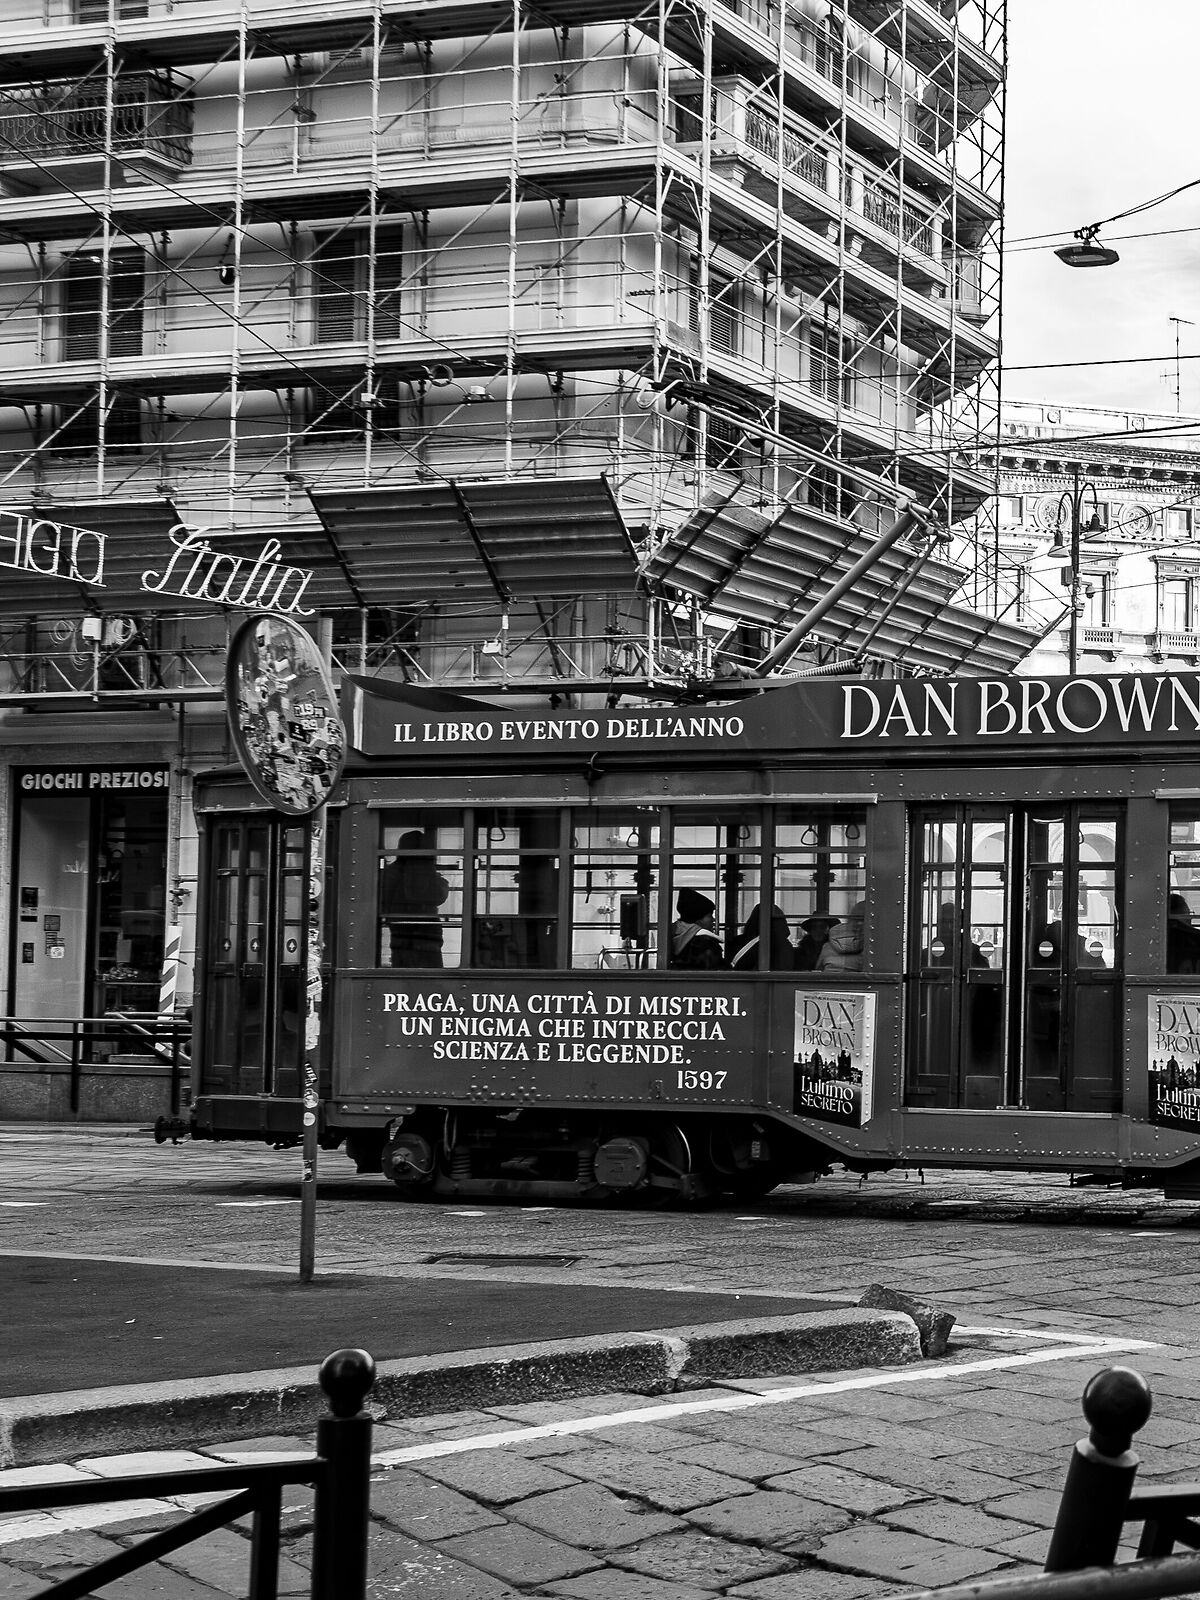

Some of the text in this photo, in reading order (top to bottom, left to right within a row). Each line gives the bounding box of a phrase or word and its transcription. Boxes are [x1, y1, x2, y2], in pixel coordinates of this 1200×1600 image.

[140, 523, 315, 616] Italia
[841, 683, 958, 738] DAN
[394, 716, 744, 742] IL LIBRO EVENTO DELL'ANNO
[21, 771, 170, 790] GIOCHI PREZIOSI
[383, 990, 747, 1017] PRAGA, UNA CITTÀ DI MISTERI.
[803, 1000, 856, 1031] DAN
[401, 1017, 726, 1041] UN ENIGMA CHE INTRECCIA
[802, 1028, 856, 1050] BROWN
[433, 1041, 692, 1065] SCIENZA E LEGGENDE.
[677, 1070, 728, 1090] 1597
[801, 1093, 853, 1114] SEGRETO
